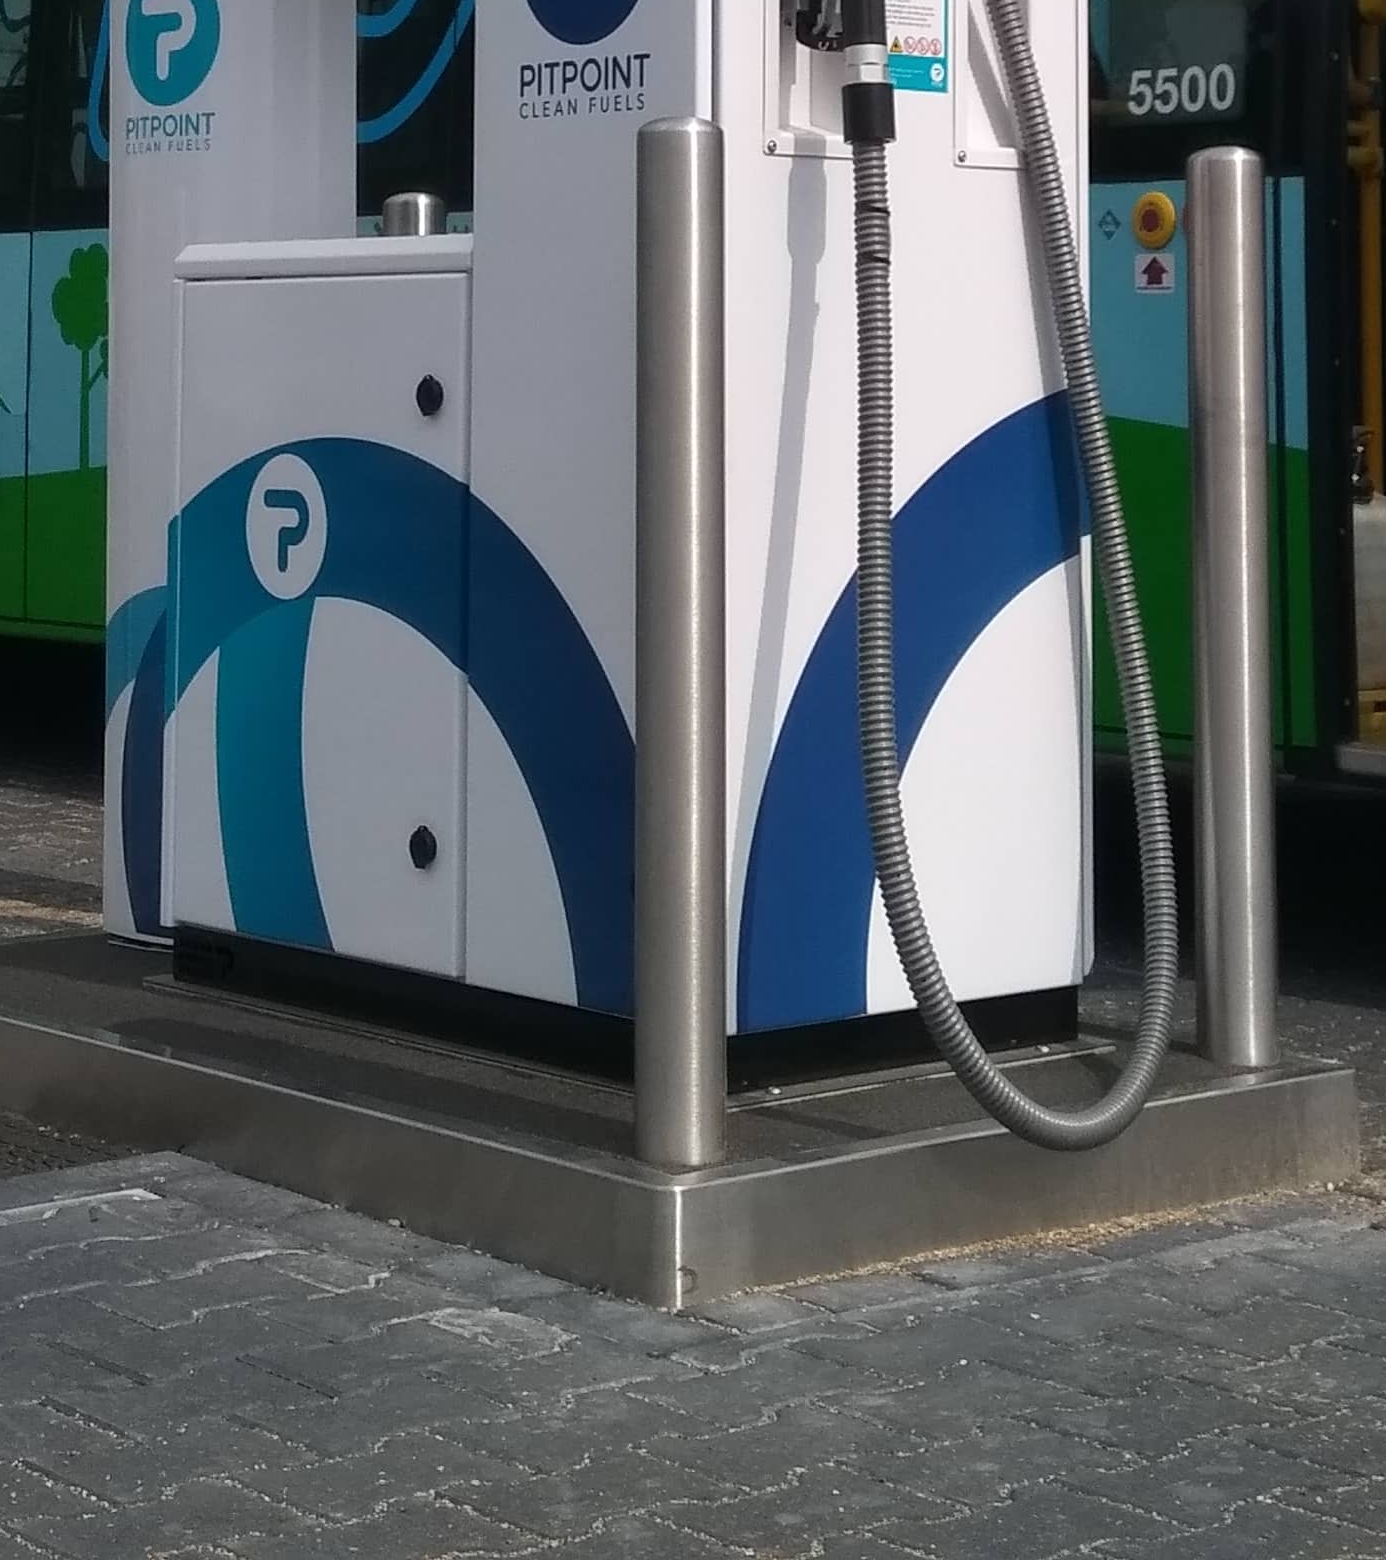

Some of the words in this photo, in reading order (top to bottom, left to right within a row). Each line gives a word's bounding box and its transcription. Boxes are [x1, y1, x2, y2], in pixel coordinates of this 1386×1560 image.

[520, 53, 651, 98] PITPOINT
[1127, 63, 1236, 116] 5500
[519, 98, 578, 120] CLEAN
[588, 93, 645, 114] FUELS
[125, 112, 216, 141] PITPOINT
[125, 141, 161, 156] CLEAN
[168, 138, 212, 153] FUELS
